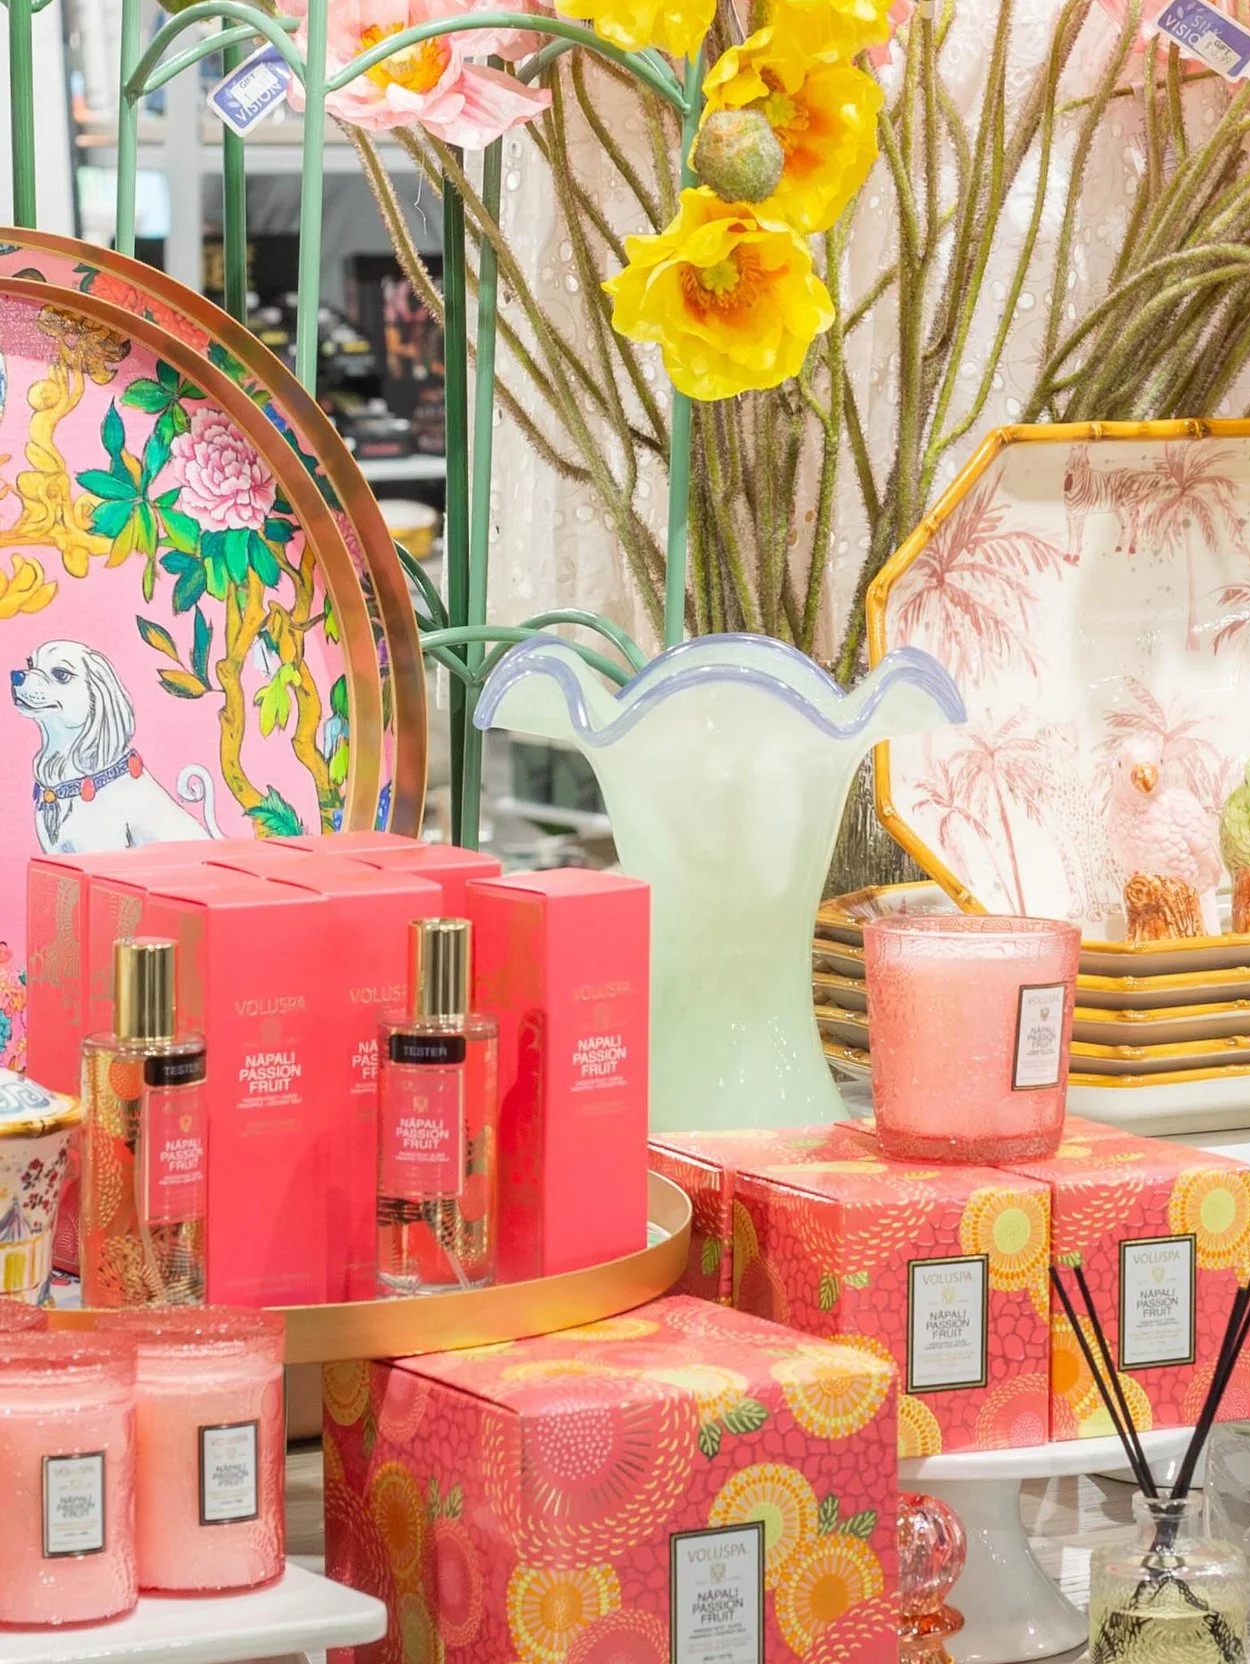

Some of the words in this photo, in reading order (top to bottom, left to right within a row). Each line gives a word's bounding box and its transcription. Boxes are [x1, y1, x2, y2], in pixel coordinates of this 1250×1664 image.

[1165, 14, 1201, 45] VISIO
[1213, 39, 1232, 56] GIFT
[239, 73, 256, 89] GIFT
[235, 82, 282, 122] VISION
[348, 985, 408, 1004] VOLUSP
[235, 995, 305, 1017] VOLUSPA
[403, 1045, 449, 1057] TESTER
[572, 1047, 627, 1065] PASSION
[239, 1065, 302, 1082] PASSION
[581, 1061, 618, 1077] FRUIT
[249, 1078, 292, 1094] FRUIT
[396, 1126, 450, 1140] PASSION
[403, 1138, 441, 1150] FRUIT
[1132, 1250, 1181, 1265] VOLUSPA
[922, 1271, 972, 1286] VOLUSPA
[1136, 1297, 1179, 1309] PASSION
[1142, 1306, 1173, 1318] FRUIT
[926, 1318, 970, 1331] PASSION
[932, 1328, 963, 1340] FRUIT
[687, 1543, 747, 1564] VOLUSPA
[692, 1597, 744, 1615] PASSION
[700, 1609, 735, 1625] FRUIT
